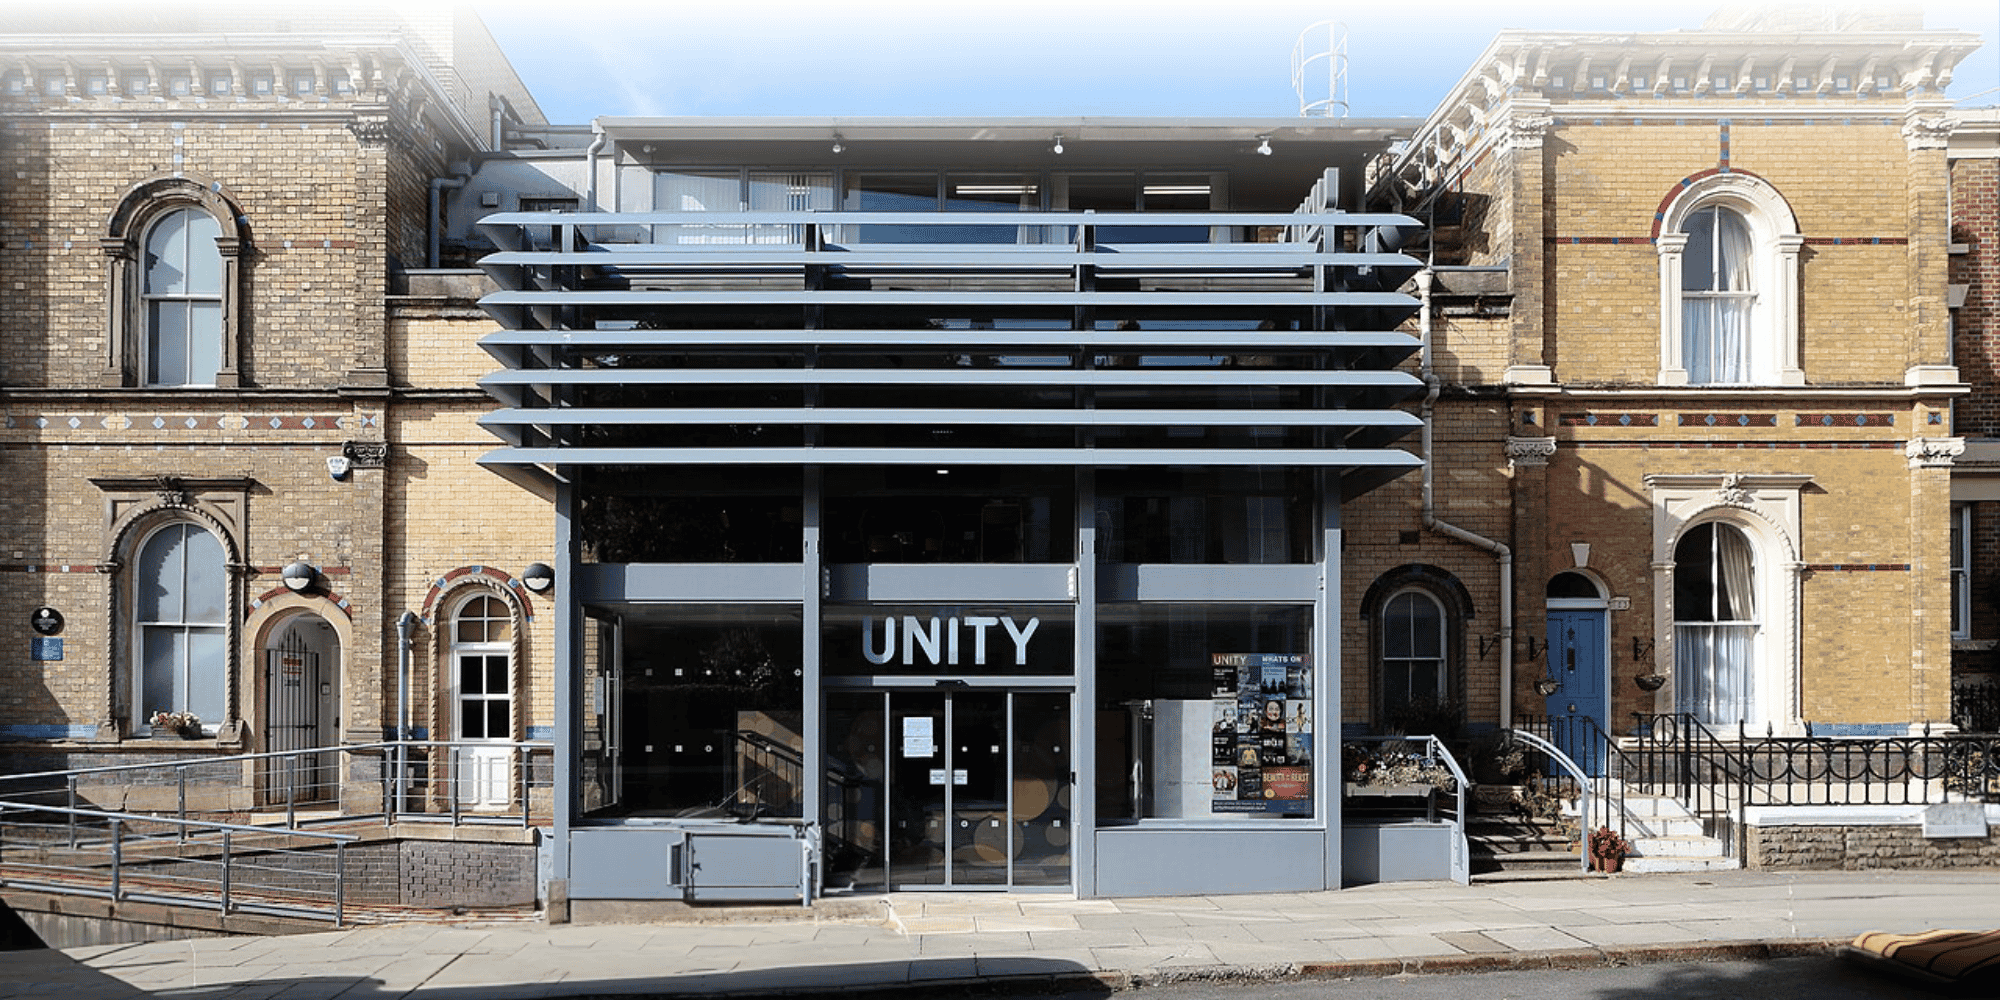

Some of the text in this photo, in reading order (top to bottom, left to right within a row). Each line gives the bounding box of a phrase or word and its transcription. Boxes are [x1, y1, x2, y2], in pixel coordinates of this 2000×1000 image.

[862, 616, 1040, 665] UNITY
[1213, 655, 1247, 665] UNITY
[1290, 655, 1302, 663] ON
